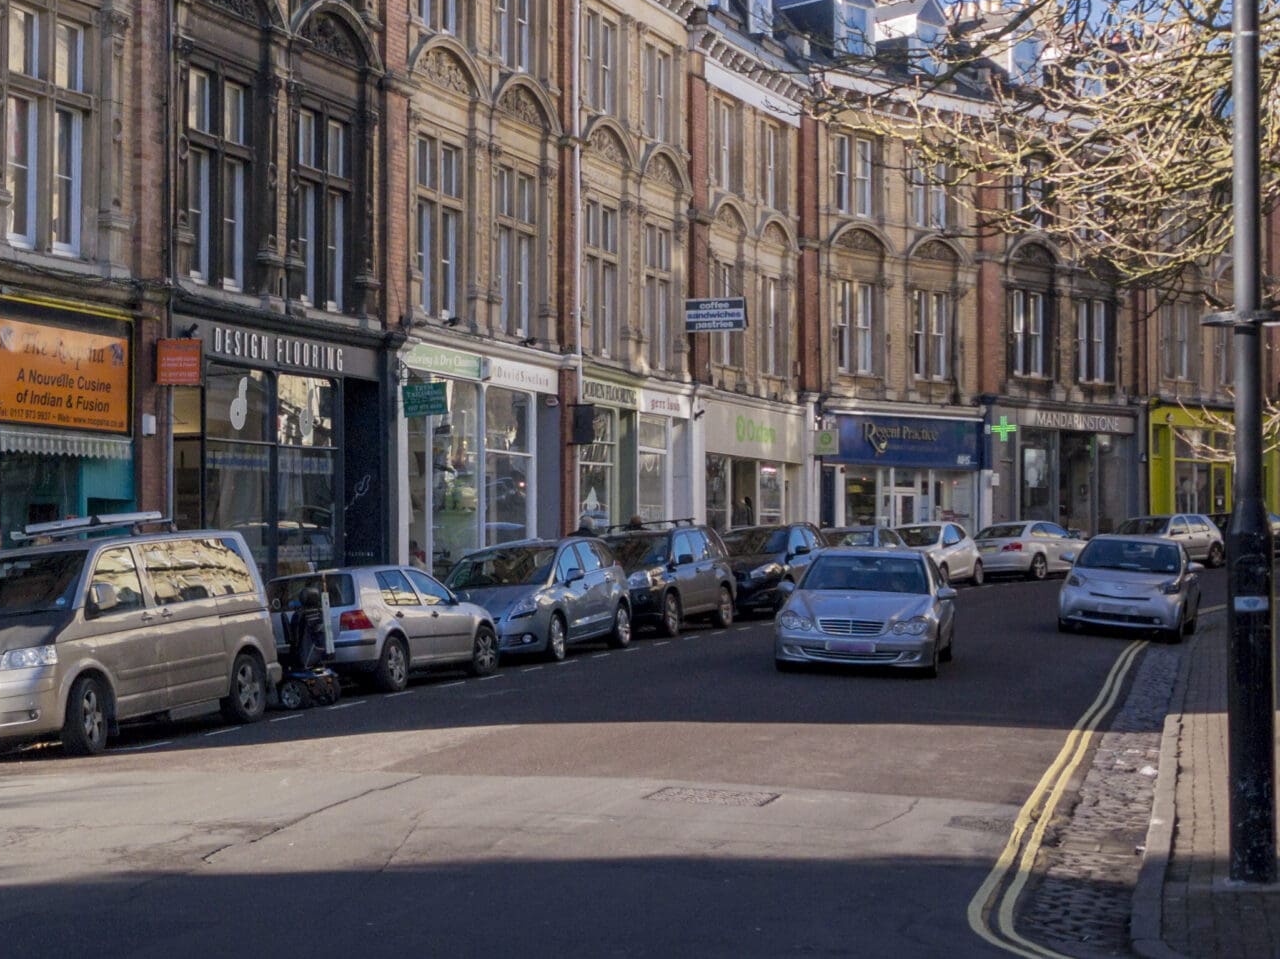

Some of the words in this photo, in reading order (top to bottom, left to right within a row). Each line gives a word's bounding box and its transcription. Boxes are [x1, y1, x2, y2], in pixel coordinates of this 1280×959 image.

[699, 301, 730, 310] coffee
[687, 311, 741, 320] sandwiches
[695, 321, 734, 330] pastries
[214, 327, 268, 361] DESIGN
[276, 338, 343, 371] FLOORING
[17, 368, 25, 382] A
[29, 369, 75, 389] Nouvelle
[77, 376, 112, 393] Cusine
[16, 388, 28, 403] of
[30, 390, 63, 408] Indian
[65, 394, 73, 409] &
[76, 395, 110, 413] Fusion
